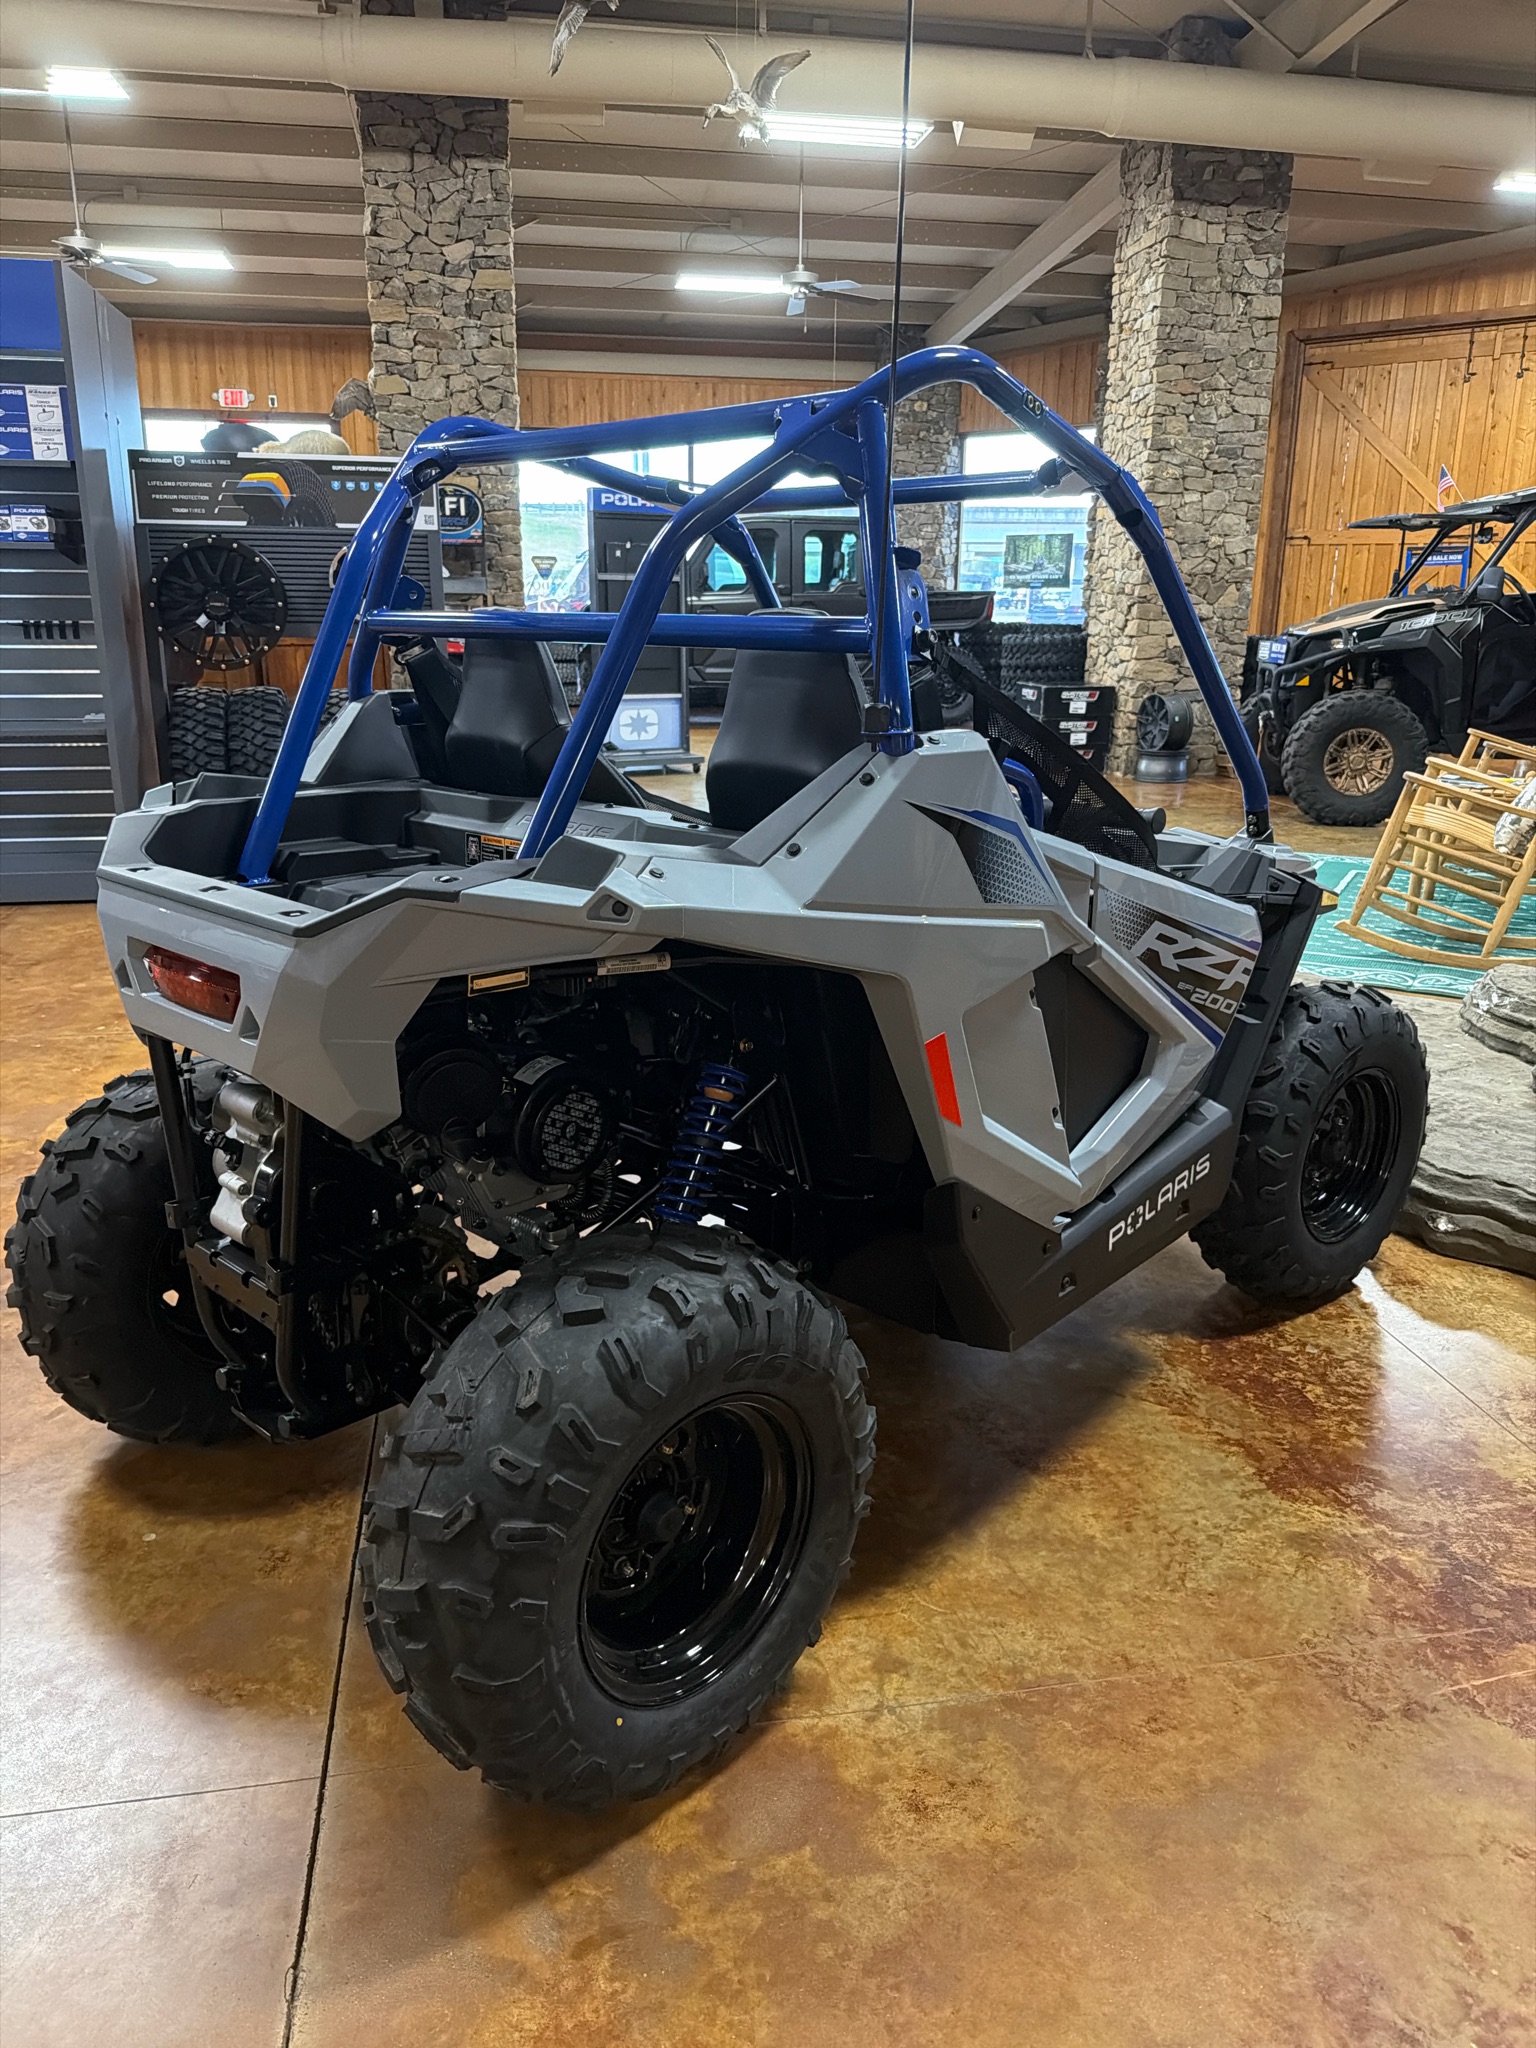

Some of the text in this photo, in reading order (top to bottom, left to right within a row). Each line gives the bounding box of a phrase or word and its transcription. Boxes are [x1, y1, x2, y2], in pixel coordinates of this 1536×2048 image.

[223, 390, 243, 406] EXIT
[1400, 609, 1468, 631] 1000
[1176, 981, 1238, 1014] EFI 200
[1108, 1152, 1211, 1252] POLARIS
